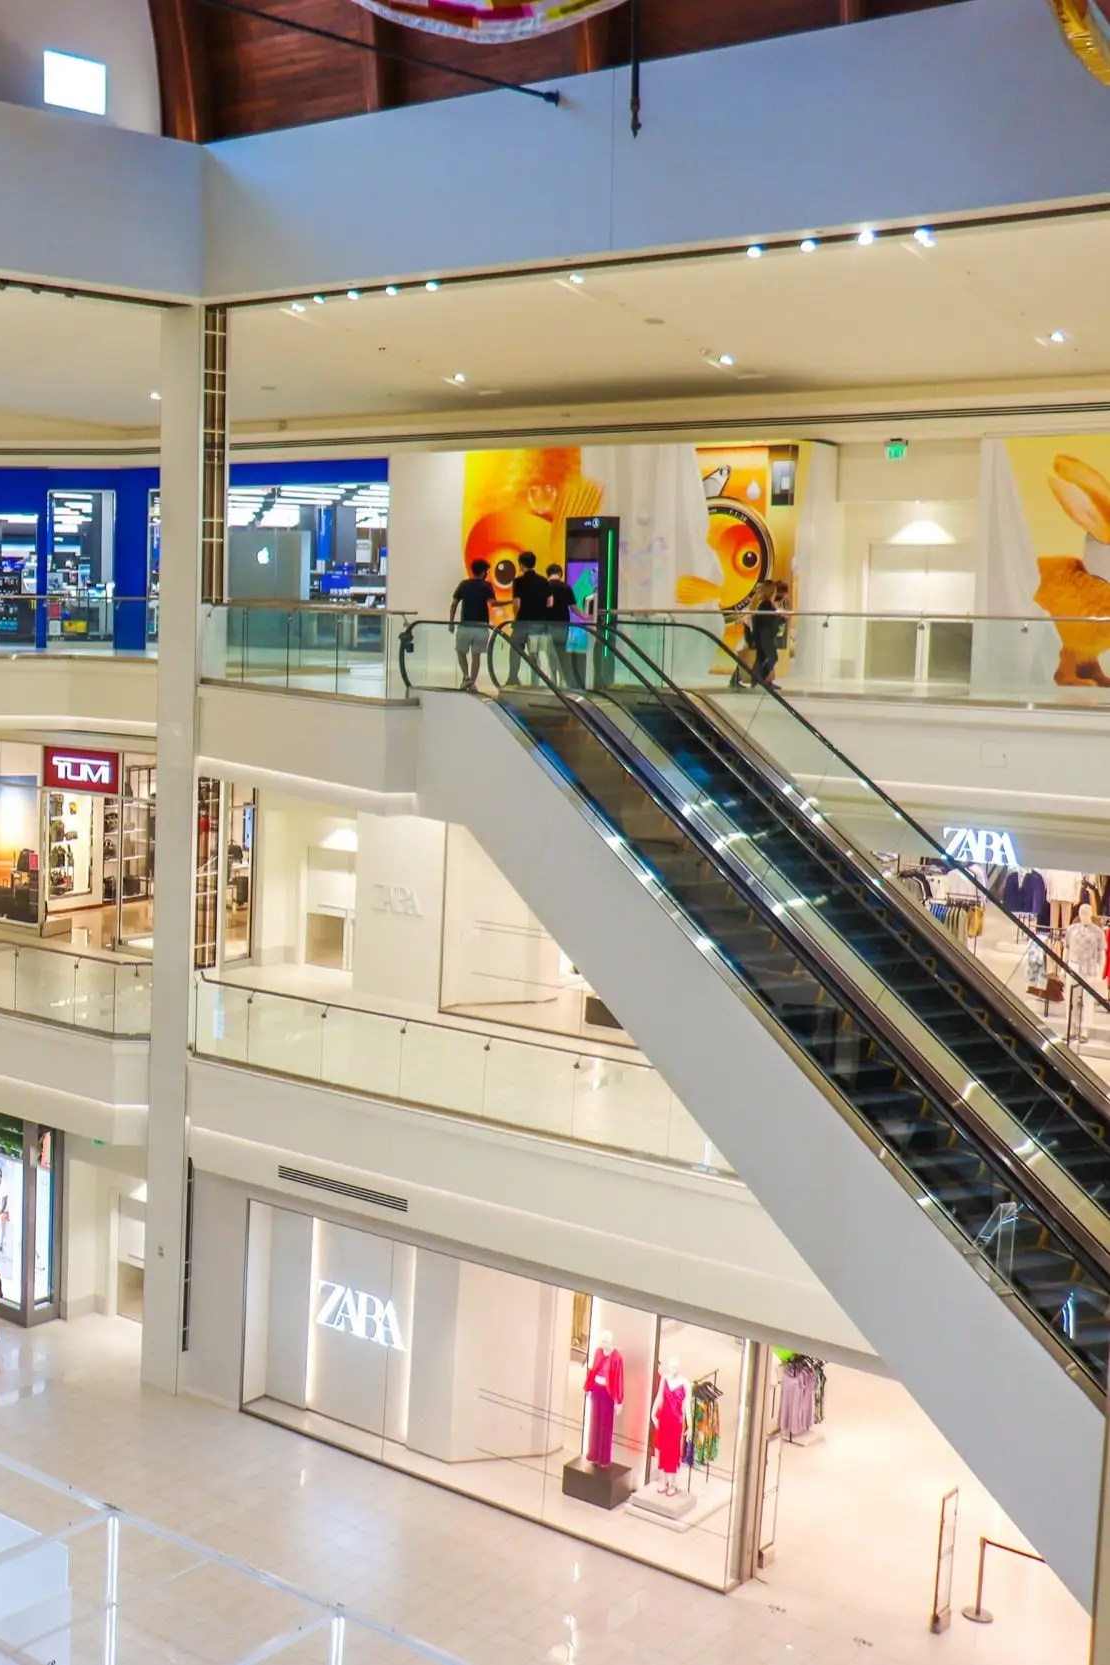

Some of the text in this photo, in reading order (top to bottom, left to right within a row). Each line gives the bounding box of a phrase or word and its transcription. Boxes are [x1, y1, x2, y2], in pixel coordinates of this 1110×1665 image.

[52, 756, 110, 784] TUMI
[942, 826, 1020, 870] ZARA
[315, 1280, 408, 1352] ZARA
